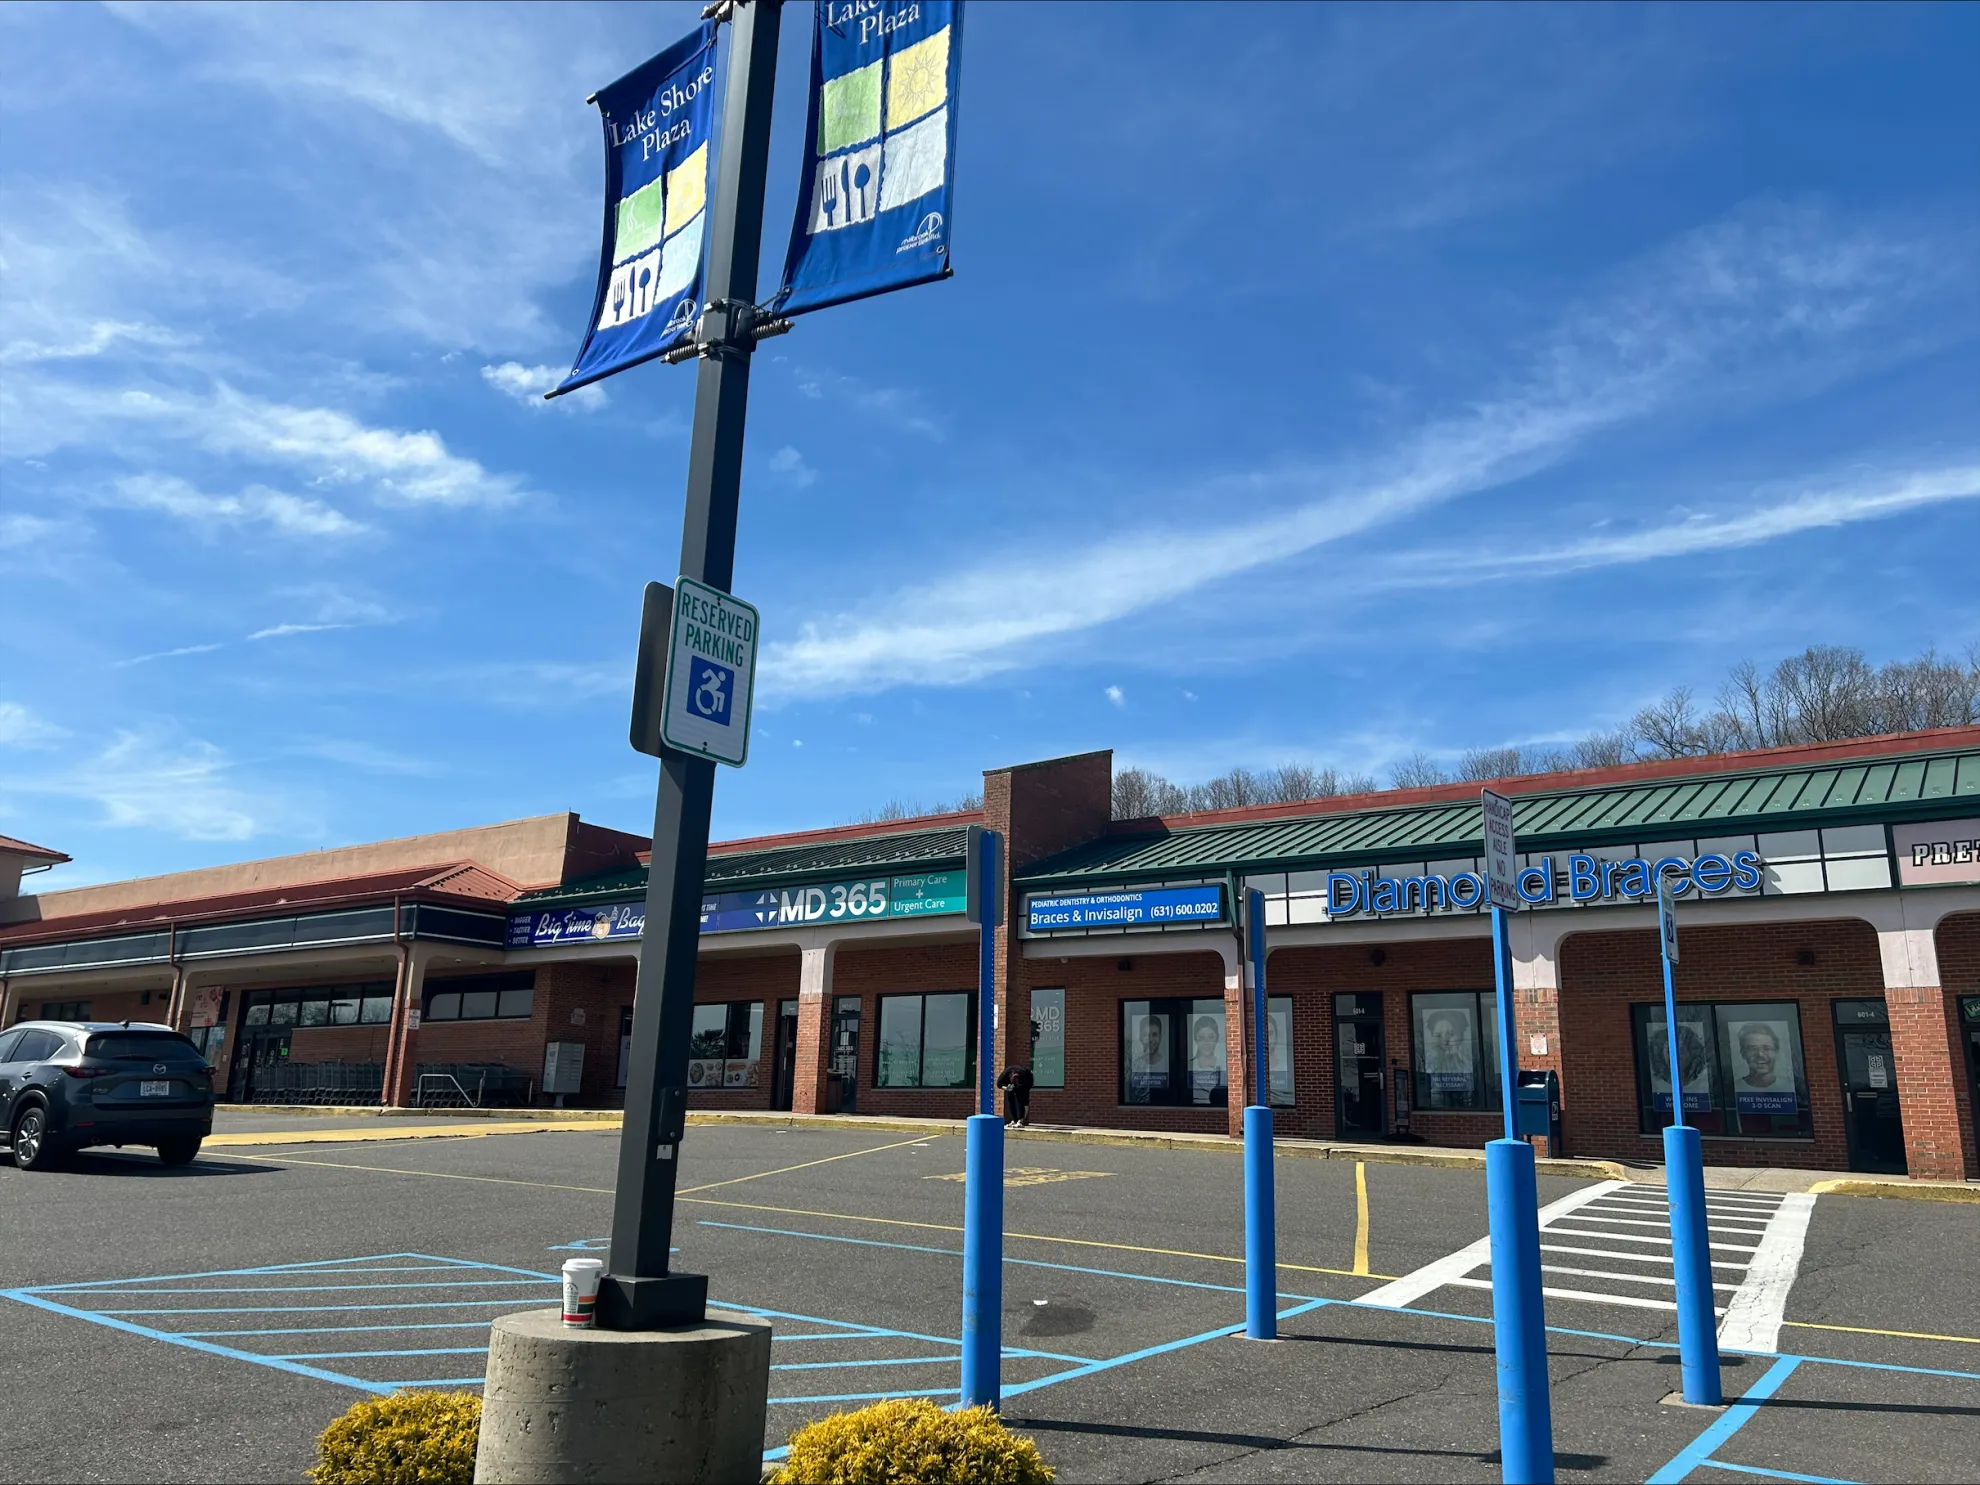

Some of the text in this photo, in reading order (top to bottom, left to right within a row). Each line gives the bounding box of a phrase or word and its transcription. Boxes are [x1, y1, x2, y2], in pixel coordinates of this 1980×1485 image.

[859, 3, 920, 46] Plaza
[609, 65, 713, 148] Lake Shore
[641, 118, 691, 162] Plaza
[681, 592, 751, 642] RESERVED
[685, 623, 744, 668] PARKING
[1489, 819, 1509, 838] ACCESS
[1493, 837, 1508, 856] AISLE
[1496, 858, 1506, 877] NO
[893, 875, 947, 888] Primary Care
[1326, 855, 1554, 915] Diamod
[1568, 850, 1762, 901] Braces
[1489, 877, 1516, 901] PARKING
[779, 881, 886, 922] MD 365
[893, 898, 945, 913] Urgent Care
[1031, 900, 1059, 908] PEDIATRIC
[1059, 898, 1089, 906] DENTISTRY
[1096, 893, 1142, 904] ORTHODONTICS
[1150, 902, 1218, 918] (631) 600.0202
[1030, 906, 1142, 925] Braces & Invisalign
[535, 913, 562, 943] Big
[564, 911, 592, 934] Time
[1035, 1006, 1060, 1020] MD
[1035, 1021, 1060, 1032] 365
